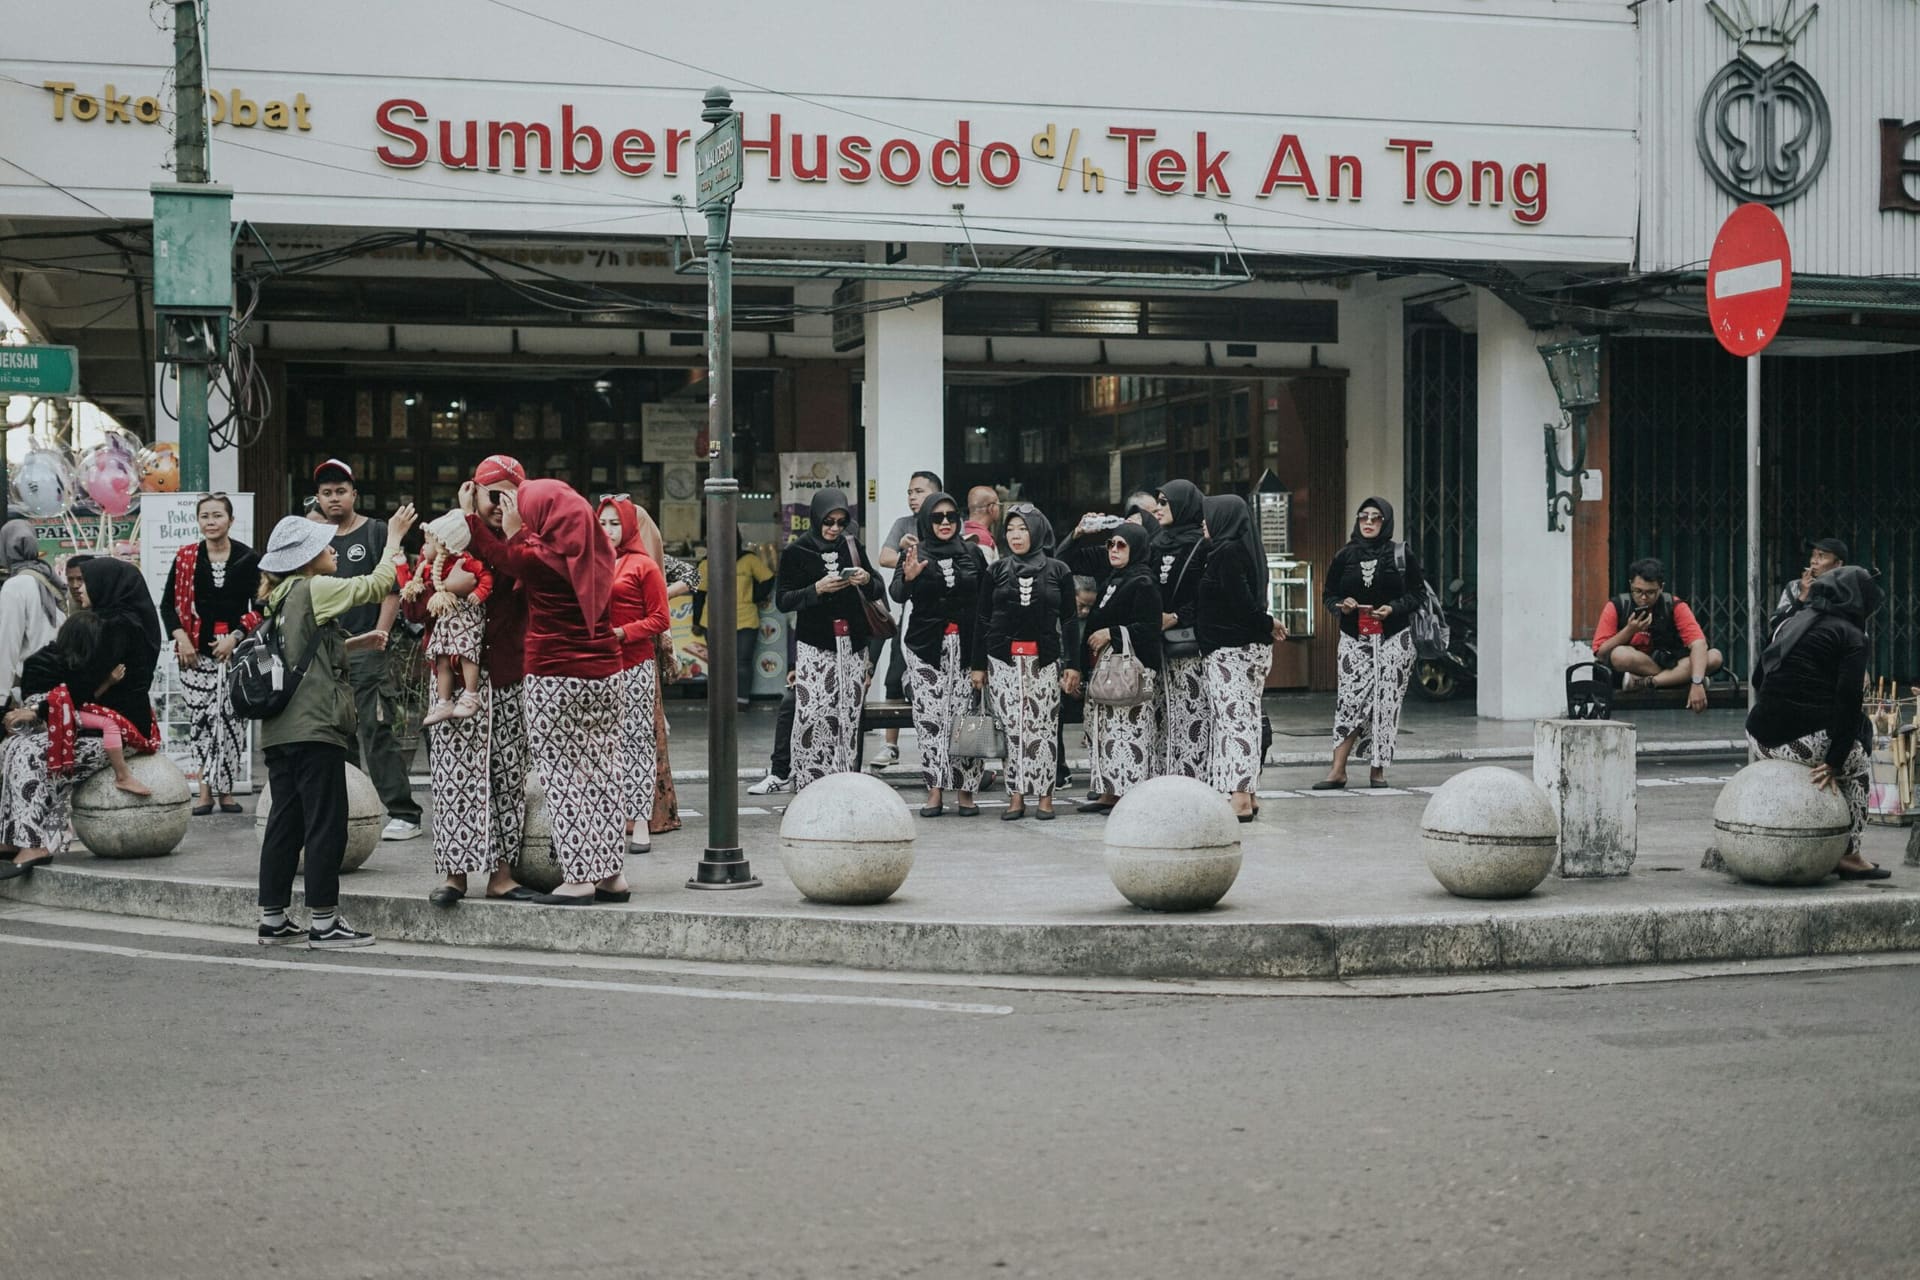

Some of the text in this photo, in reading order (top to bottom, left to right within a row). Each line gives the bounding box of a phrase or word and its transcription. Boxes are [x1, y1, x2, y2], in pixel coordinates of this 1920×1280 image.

[43, 80, 312, 132] Toko Obat
[375, 98, 1549, 225] Sumber Husodo d/h Tek An Tong
[160, 524, 199, 539] Blang
[167, 510, 197, 524] Poko
